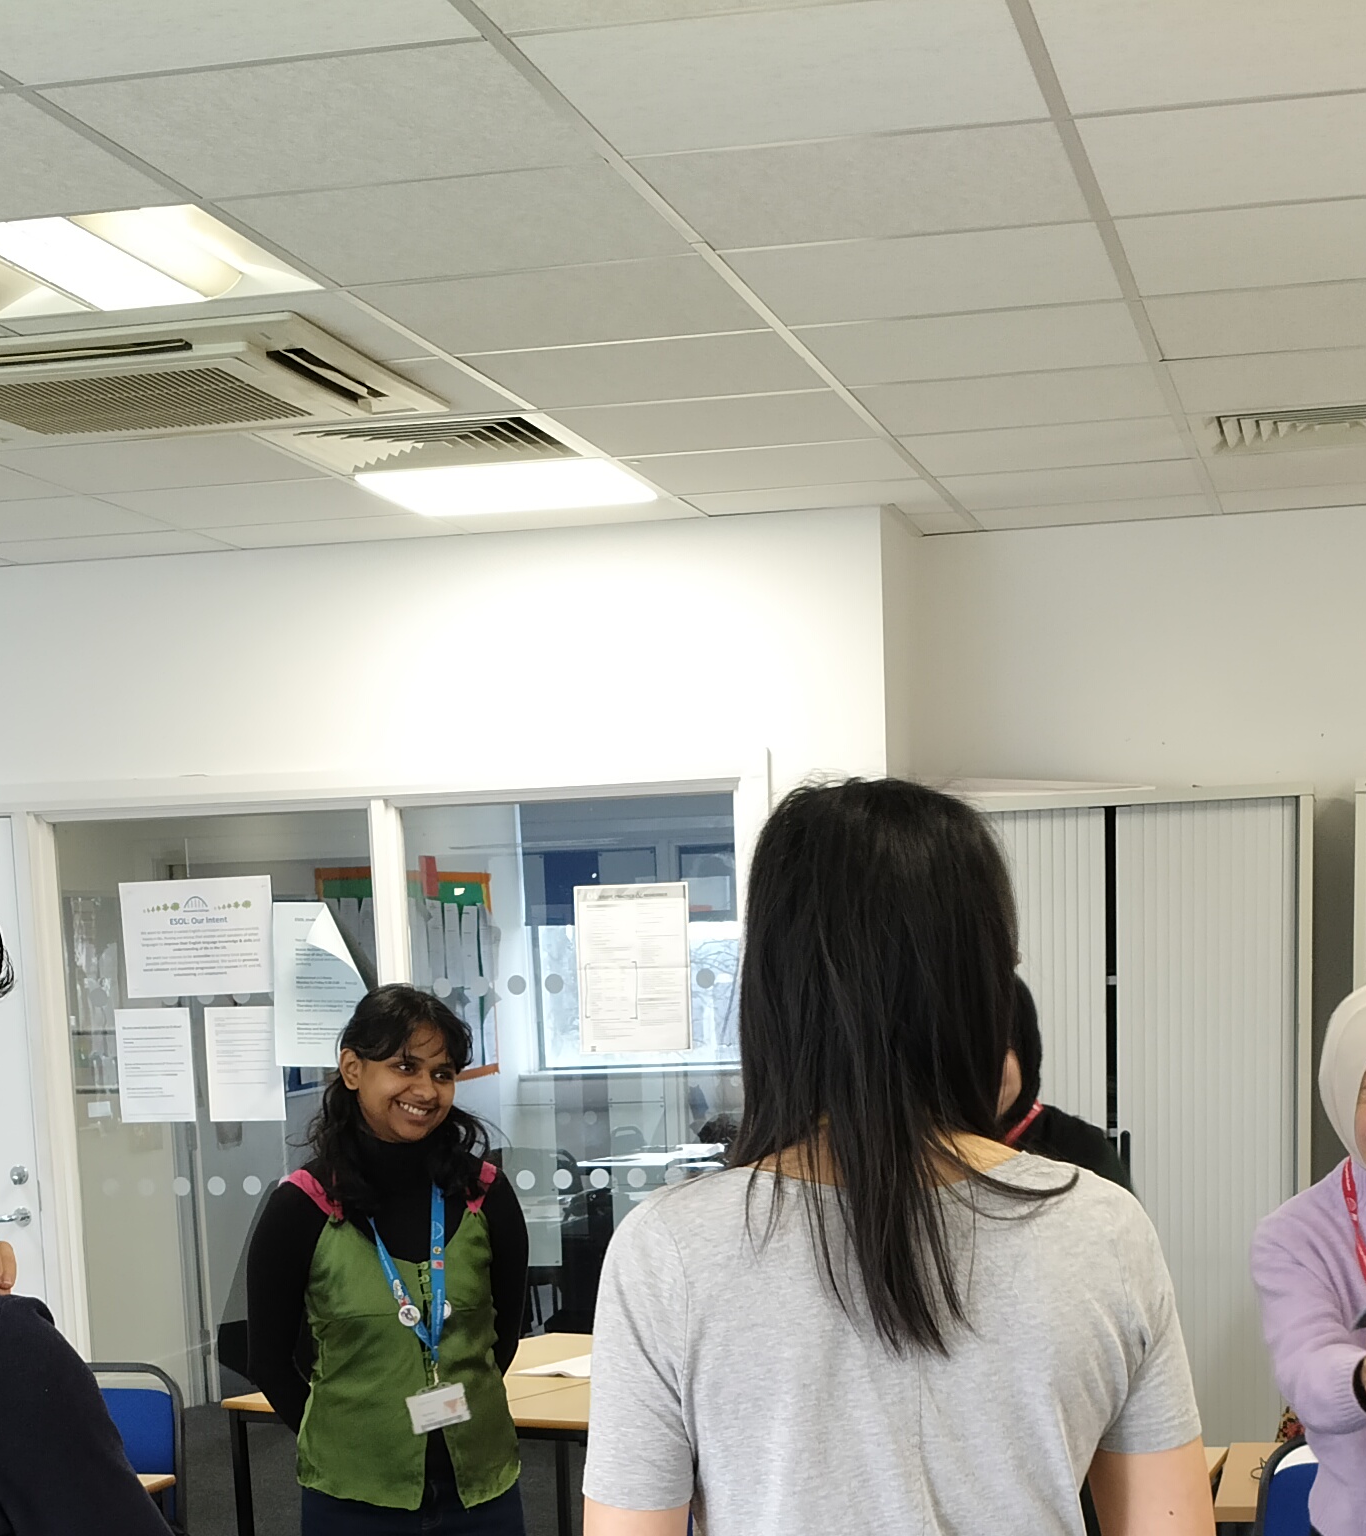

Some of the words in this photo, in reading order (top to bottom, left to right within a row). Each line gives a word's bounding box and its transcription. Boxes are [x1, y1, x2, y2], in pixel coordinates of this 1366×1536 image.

[169, 917, 190, 926] ESOL:
[190, 916, 205, 925] Our
[205, 915, 228, 924] Intent
